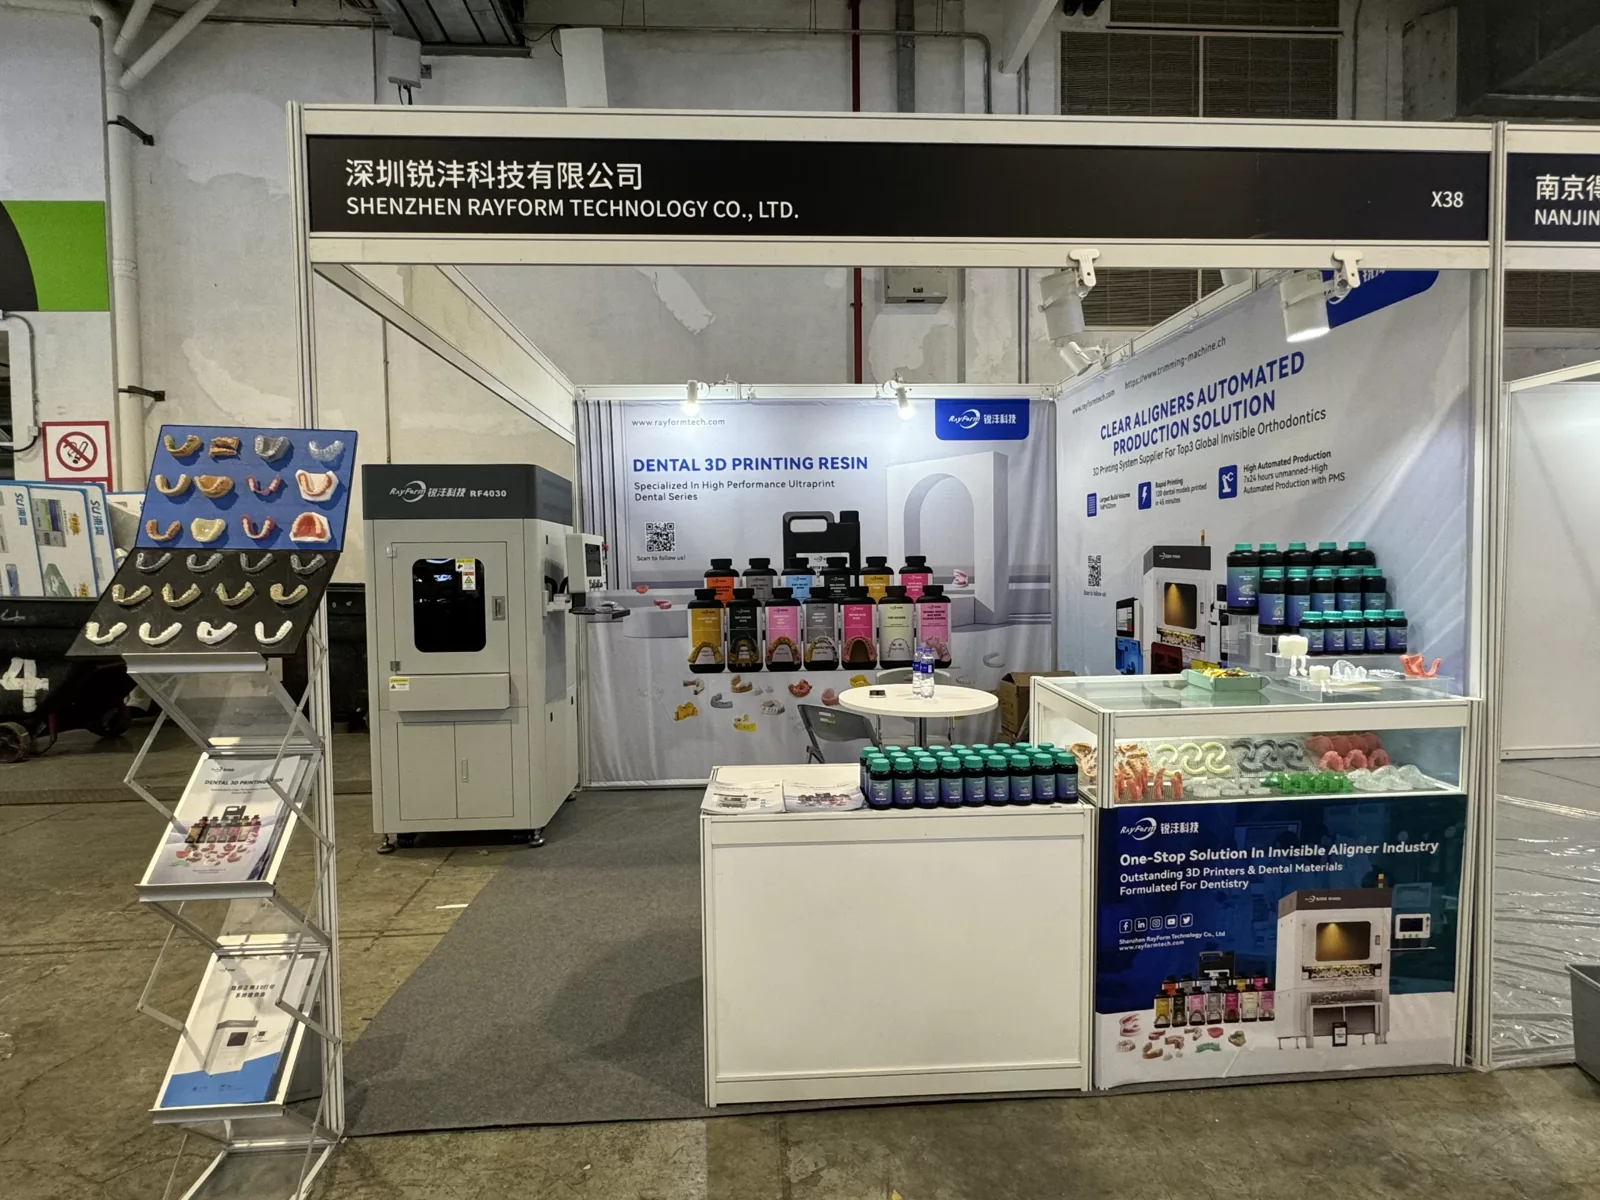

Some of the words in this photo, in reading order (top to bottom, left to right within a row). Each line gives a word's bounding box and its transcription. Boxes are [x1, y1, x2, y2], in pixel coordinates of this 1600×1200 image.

[345, 159, 643, 191] 深圳锐沣科技有限公司
[346, 196, 462, 216] SHENZHEN
[468, 198, 565, 217] RAYFORM
[569, 199, 708, 218] TECHNOLOGY
[713, 200, 754, 221] CO.,
[759, 201, 799, 219] LTD.
[1431, 190, 1464, 208] X38
[1124, 336, 1226, 390] https://www.trimming-machine.ch
[1071, 389, 1116, 415] www.rayformtech.com
[1100, 415, 1132, 440] CLEAR
[1133, 391, 1195, 429] ALIGNERS
[1196, 351, 1305, 408] AUTOMATED
[631, 417, 726, 428] www.rayformtech.com
[983, 413, 1017, 426] 锐沣科技
[1113, 417, 1190, 456] PRODUCTION
[1192, 389, 1276, 433] SOLUTION
[1099, 460, 1119, 475] Printing
[1119, 456, 1139, 471] System
[1139, 450, 1164, 466] Supplier
[1165, 446, 1176, 459] For
[1177, 441, 1194, 457] Top3
[1195, 434, 1219, 451] Global
[1220, 424, 1256, 445] Invisible
[1257, 408, 1327, 435] Orthodontics
[633, 457, 701, 473] DENTAL
[704, 457, 727, 472] 3D
[732, 457, 815, 471] PRINTING
[819, 456, 868, 470] RESIN
[1243, 461, 1257, 474] High
[1257, 456, 1292, 471] Automated
[1292, 449, 1332, 464] Production
[1257, 471, 1274, 482] hours
[1274, 462, 1329, 479] unmanned-High
[633, 480, 688, 492] Specialized
[690, 480, 699, 490] In
[701, 480, 725, 491] High
[727, 479, 786, 489] Performance
[788, 478, 836, 490] Ultraprint
[1167, 478, 1184, 487] Printing
[1243, 482, 1274, 495] Automated
[1275, 478, 1310, 492] Production
[1311, 475, 1327, 485] with
[1328, 472, 1346, 484] PMS
[427, 487, 467, 498] 锐沣科技
[469, 489, 507, 498] RF4030
[635, 492, 665, 502] Dental
[668, 492, 699, 502] Series
[0, 657, 49, 713] 4
[1160, 821, 1199, 835] 锐沣科技
[1120, 851, 1186, 866] One-Stop
[1189, 847, 1248, 862] Solution
[1251, 847, 1264, 859] In
[1268, 844, 1326, 858] Invisible
[1328, 843, 1380, 858] Aligner
[1382, 840, 1440, 855] Industry
[1120, 869, 1183, 883] Outstanding
[1185, 867, 1200, 877] 3D
[1203, 866, 1245, 877] Printers
[1247, 865, 1256, 875] &
[1258, 864, 1293, 875] Dental
[1295, 862, 1344, 873] Materials
[1120, 882, 1177, 896] Formulated
[1180, 880, 1198, 891] For
[1200, 879, 1250, 890] Dentistry
[1119, 937, 1146, 945] Shenzhen
[1146, 935, 1171, 944] RayForm
[1171, 932, 1203, 942] Technology
[1119, 939, 1185, 951] www.rayformtech.com
